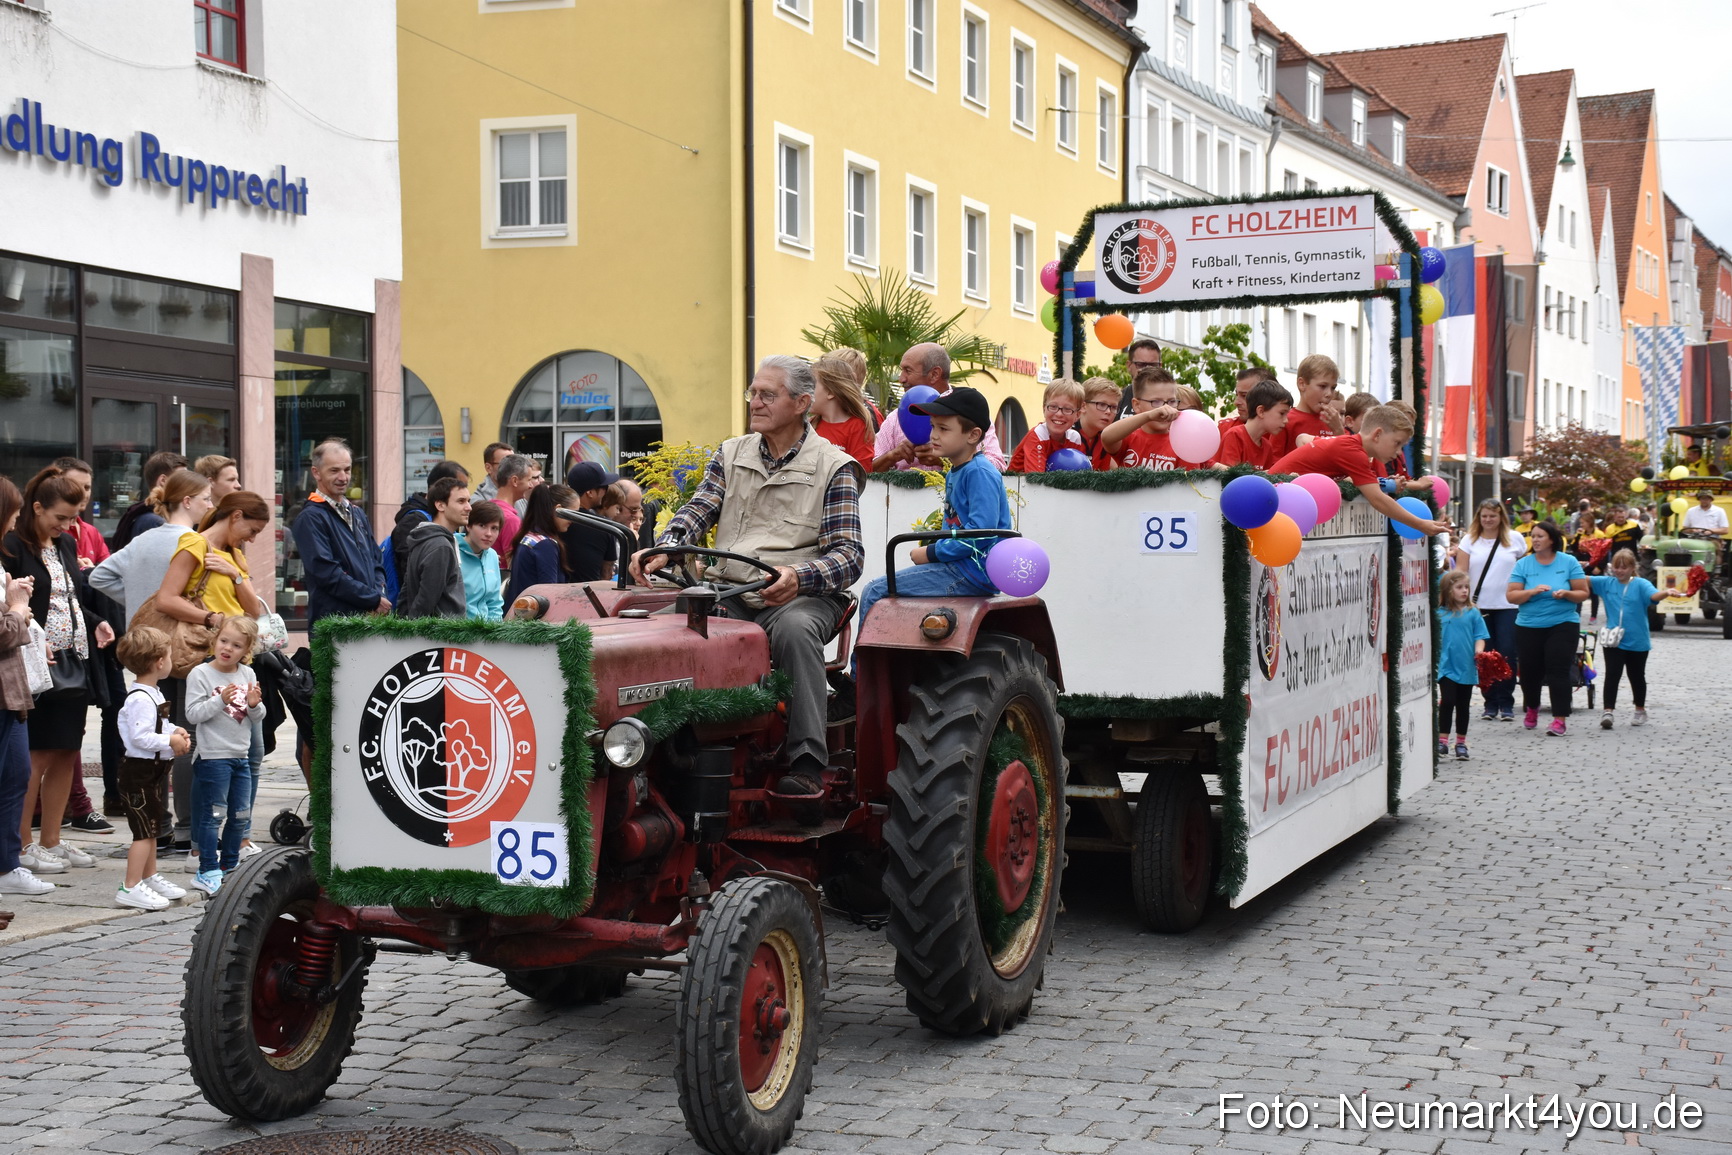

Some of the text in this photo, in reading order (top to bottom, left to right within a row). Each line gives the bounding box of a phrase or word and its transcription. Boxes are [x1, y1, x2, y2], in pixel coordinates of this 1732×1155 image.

[0, 97, 309, 217] dlung Rupprecht
[1191, 205, 1357, 236] FC HOLZHEIM
[1103, 220, 1175, 273] F.C. HOLZHEIM e.V.
[1192, 247, 1366, 269] Fußball, Tennis, Gymnastik,
[1192, 276, 1223, 290] Kraft
[1237, 275, 1287, 287] Fitness,
[1290, 271, 1361, 285] Kindertanz
[569, 373, 598, 394] FOTO
[620, 451, 646, 459] Digitale
[1141, 457, 1175, 472] JAKO
[1144, 516, 1188, 550] 85
[361, 650, 534, 786] F.C. HOLZHEIM e.V.
[1262, 692, 1379, 813] FC HOLZHEIM
[496, 827, 559, 881] 85
